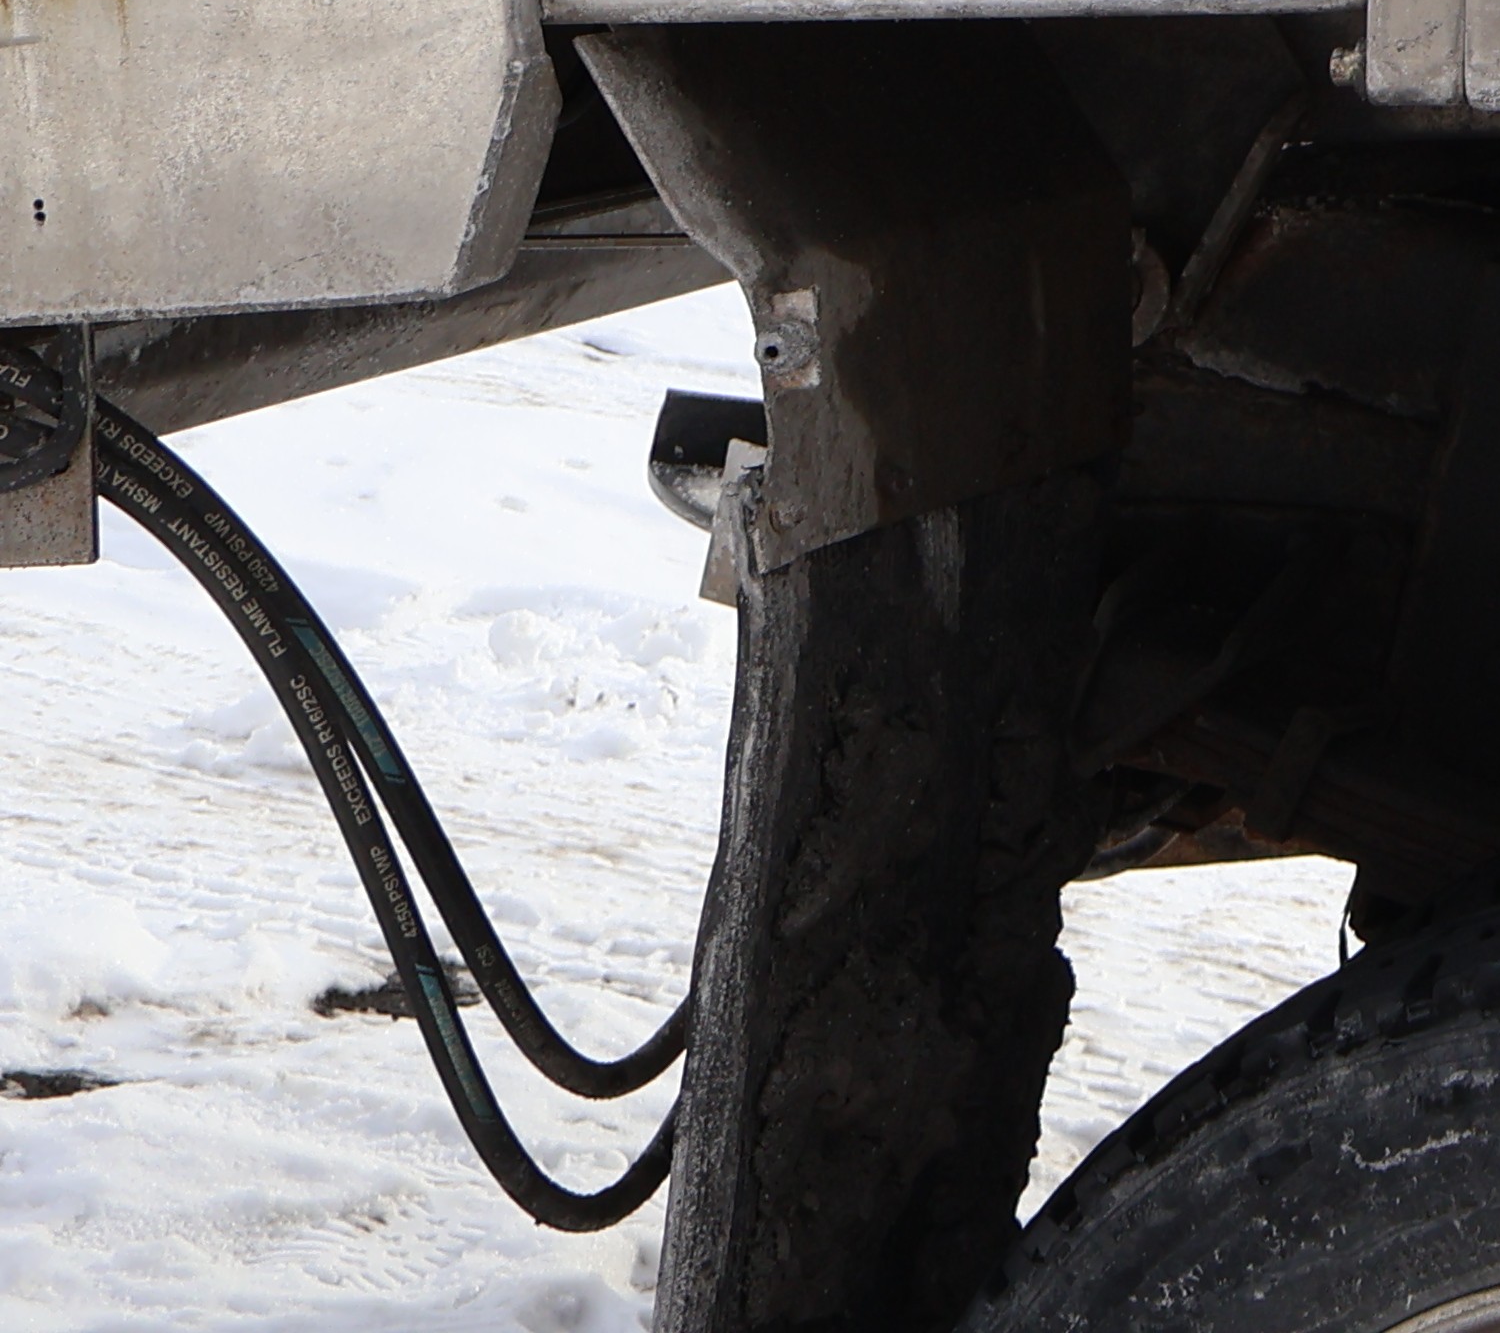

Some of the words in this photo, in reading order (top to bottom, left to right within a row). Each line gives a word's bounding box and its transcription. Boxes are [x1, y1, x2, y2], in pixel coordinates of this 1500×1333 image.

[118, 434, 195, 499] EXCEEDS
[110, 469, 163, 515] MSHA
[203, 511, 231, 539] WP
[166, 516, 249, 603] RESISTANT
[225, 533, 253, 563] PSI
[249, 557, 280, 593] 4250
[240, 597, 288, 659] FLAME
[290, 673, 336, 745] R16/2SC
[325, 743, 373, 827] EXCEEDS
[369, 845, 392, 875] WP
[381, 872, 402, 904] PSI
[393, 900, 419, 939] 4250
